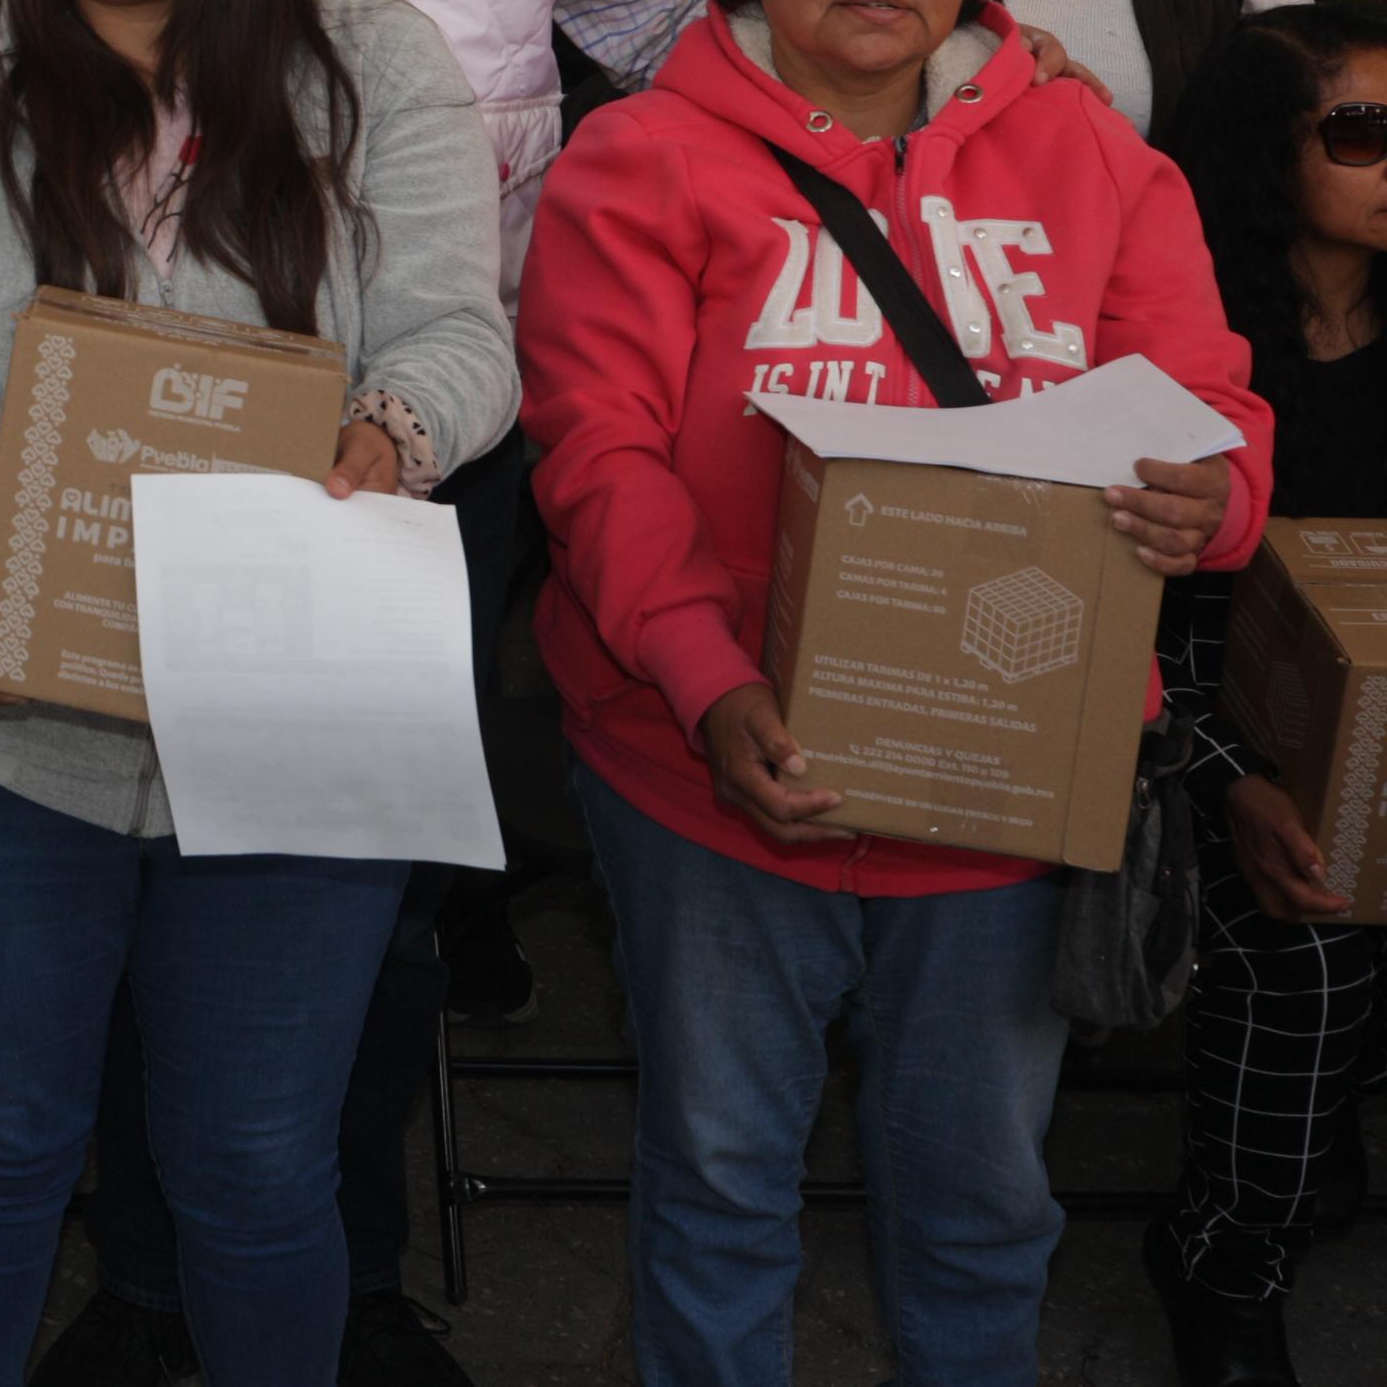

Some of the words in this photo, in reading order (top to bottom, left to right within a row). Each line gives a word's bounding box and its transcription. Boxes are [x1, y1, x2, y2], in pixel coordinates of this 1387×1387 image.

[743, 195, 1088, 372] LOVE
[149, 364, 249, 420] DIF
[806, 361, 855, 403] IN
[140, 444, 210, 472] Puebla
[880, 505, 908, 519] ESTE
[910, 510, 944, 524] LADO
[945, 514, 982, 530] HACIA
[984, 520, 1028, 537] ARRIBA
[874, 559, 895, 571] POR
[875, 576, 897, 589] POR
[869, 594, 891, 606] POR
[814, 654, 866, 671] UTILIZAR
[866, 662, 915, 680] TARIMAS
[916, 671, 933, 683] DE
[812, 669, 855, 685] ALTURA
[905, 683, 937, 699] PARA
[808, 685, 865, 704] PRIMERAS
[930, 706, 988, 725] PRIMERAS
[989, 715, 1037, 733] SALIDAS
[875, 736, 943, 757] DENUNCIAS
[945, 748, 954, 758] Y
[954, 750, 1001, 766] QUEJAS
